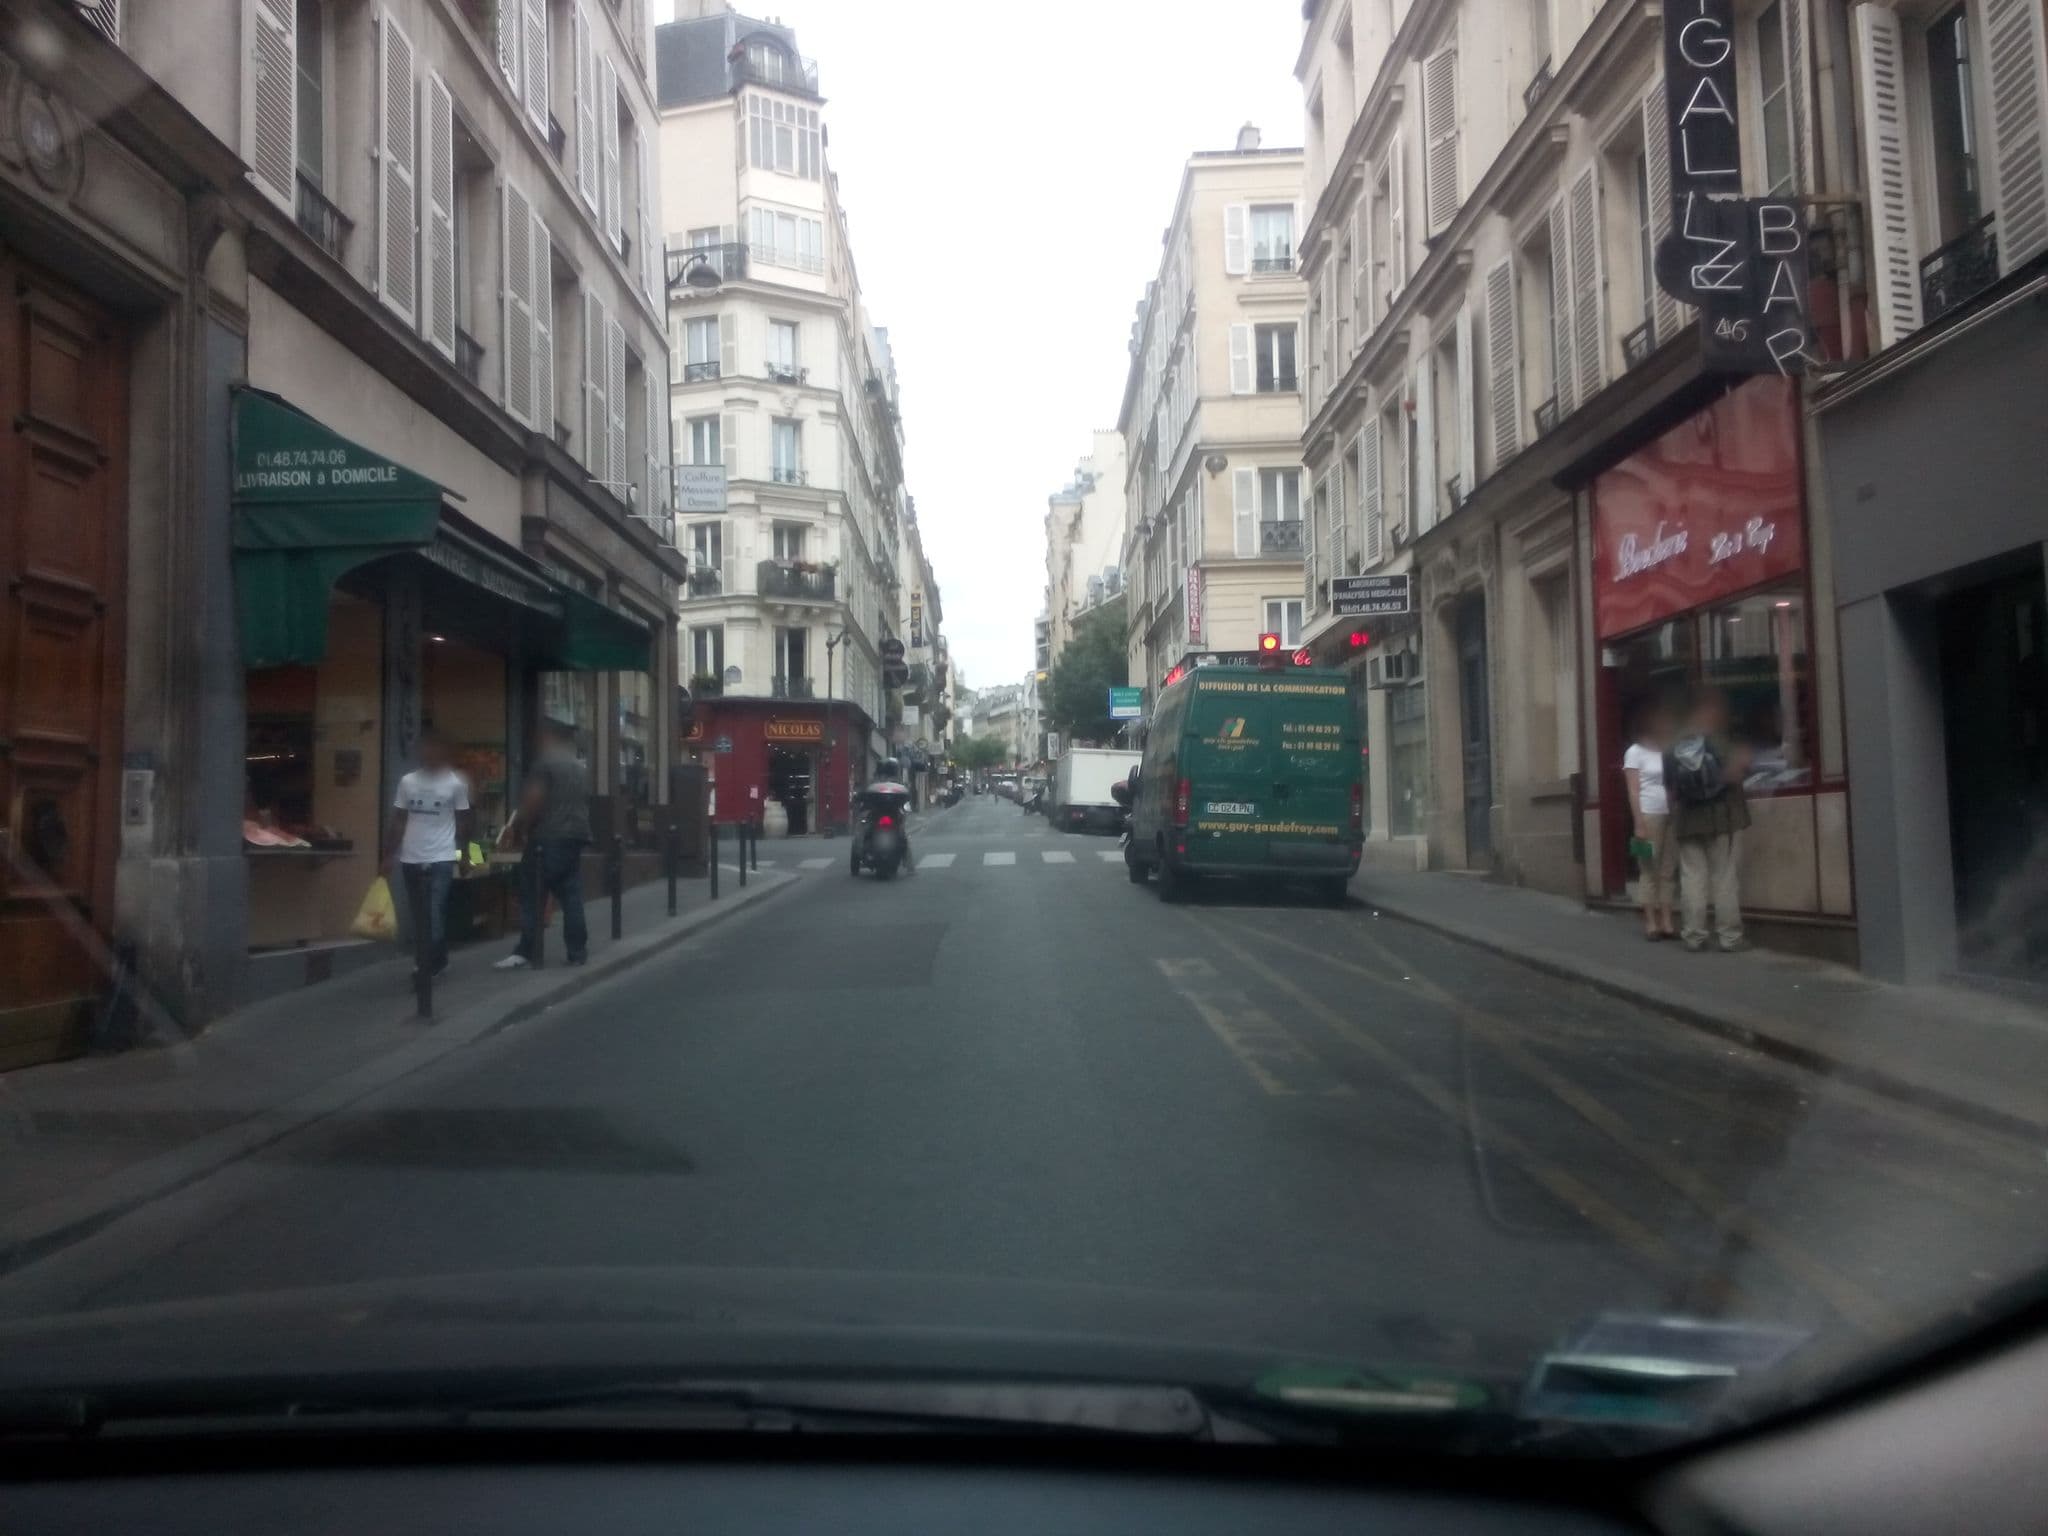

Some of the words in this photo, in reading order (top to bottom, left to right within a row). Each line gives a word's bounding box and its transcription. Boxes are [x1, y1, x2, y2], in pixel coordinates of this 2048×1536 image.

[1760, 205, 1818, 377] BAR
[238, 470, 311, 488] LIVRAISON
[331, 466, 398, 485] DOMICILE
[1199, 681, 1244, 692] DIFFUSION
[1247, 683, 1258, 692] DE
[1260, 683, 1271, 693] LA
[1273, 684, 1345, 696] COMMUNICATION
[769, 724, 820, 736] NICOLAS
[1198, 820, 1338, 836] www.guy-gaudefroy.com
